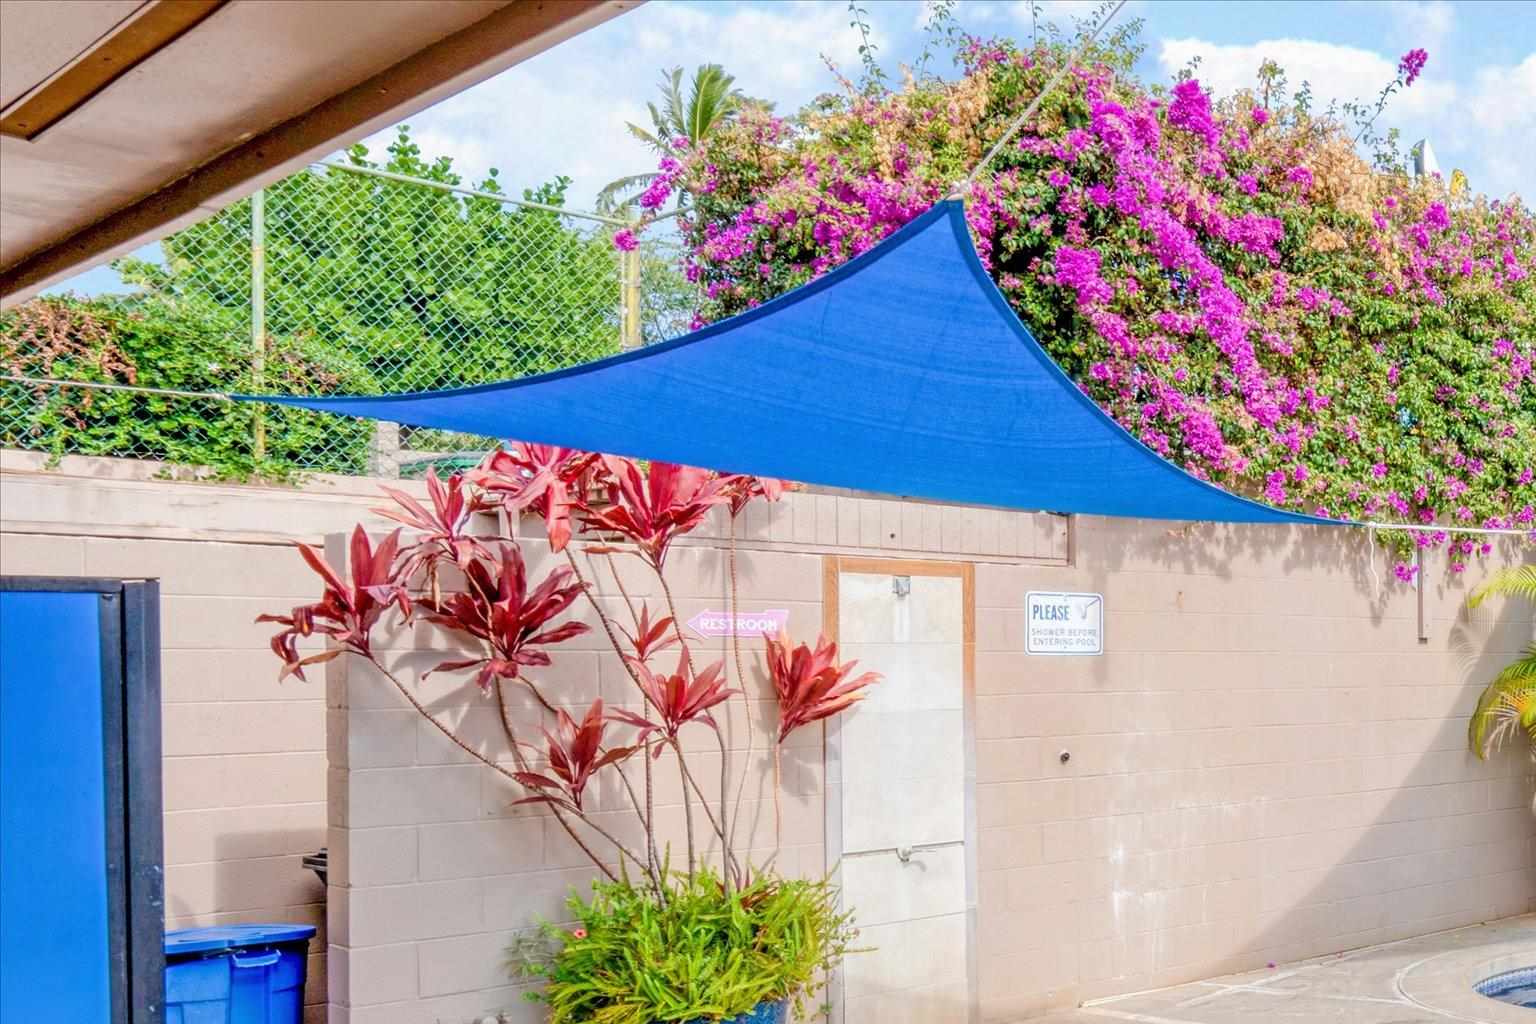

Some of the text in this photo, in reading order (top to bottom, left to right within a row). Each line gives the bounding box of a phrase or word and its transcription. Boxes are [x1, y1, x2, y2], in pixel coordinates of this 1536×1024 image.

[1032, 604, 1070, 621] PLEASE
[699, 617, 777, 631] RESTROOM
[1031, 628, 1097, 637] SHOWER BEFORE
[1032, 638, 1074, 646] ENTERING
